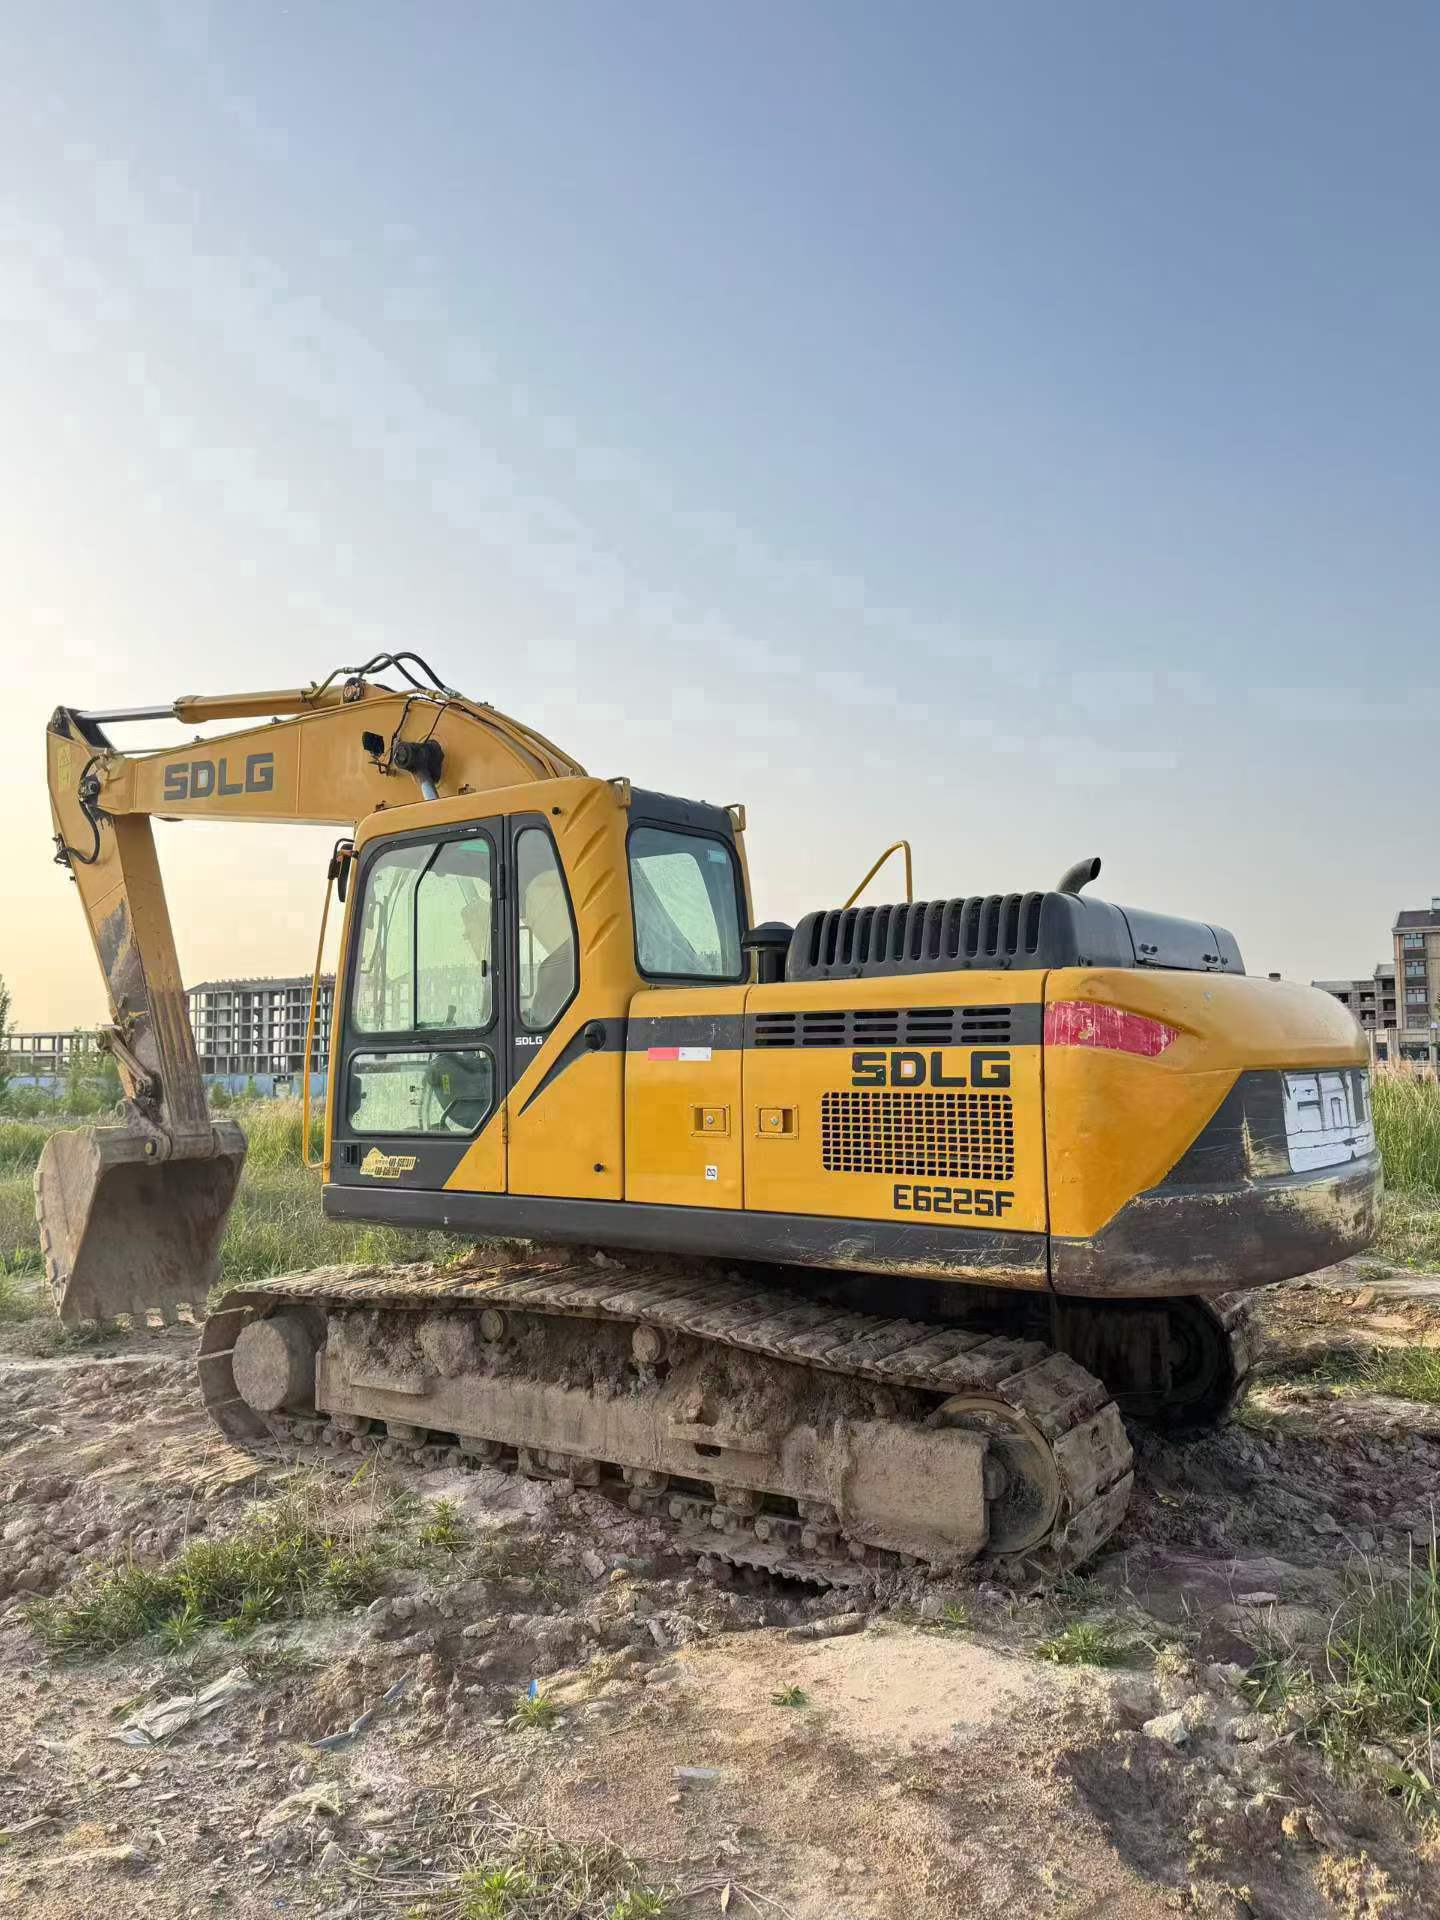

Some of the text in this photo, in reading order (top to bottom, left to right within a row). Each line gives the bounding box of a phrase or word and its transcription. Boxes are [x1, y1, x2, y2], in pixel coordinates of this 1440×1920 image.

[163, 752, 274, 801] SDLG
[515, 1036, 543, 1046] SDLG
[852, 1051, 1011, 1088] SDLG
[893, 1184, 1015, 1217] E6225F
